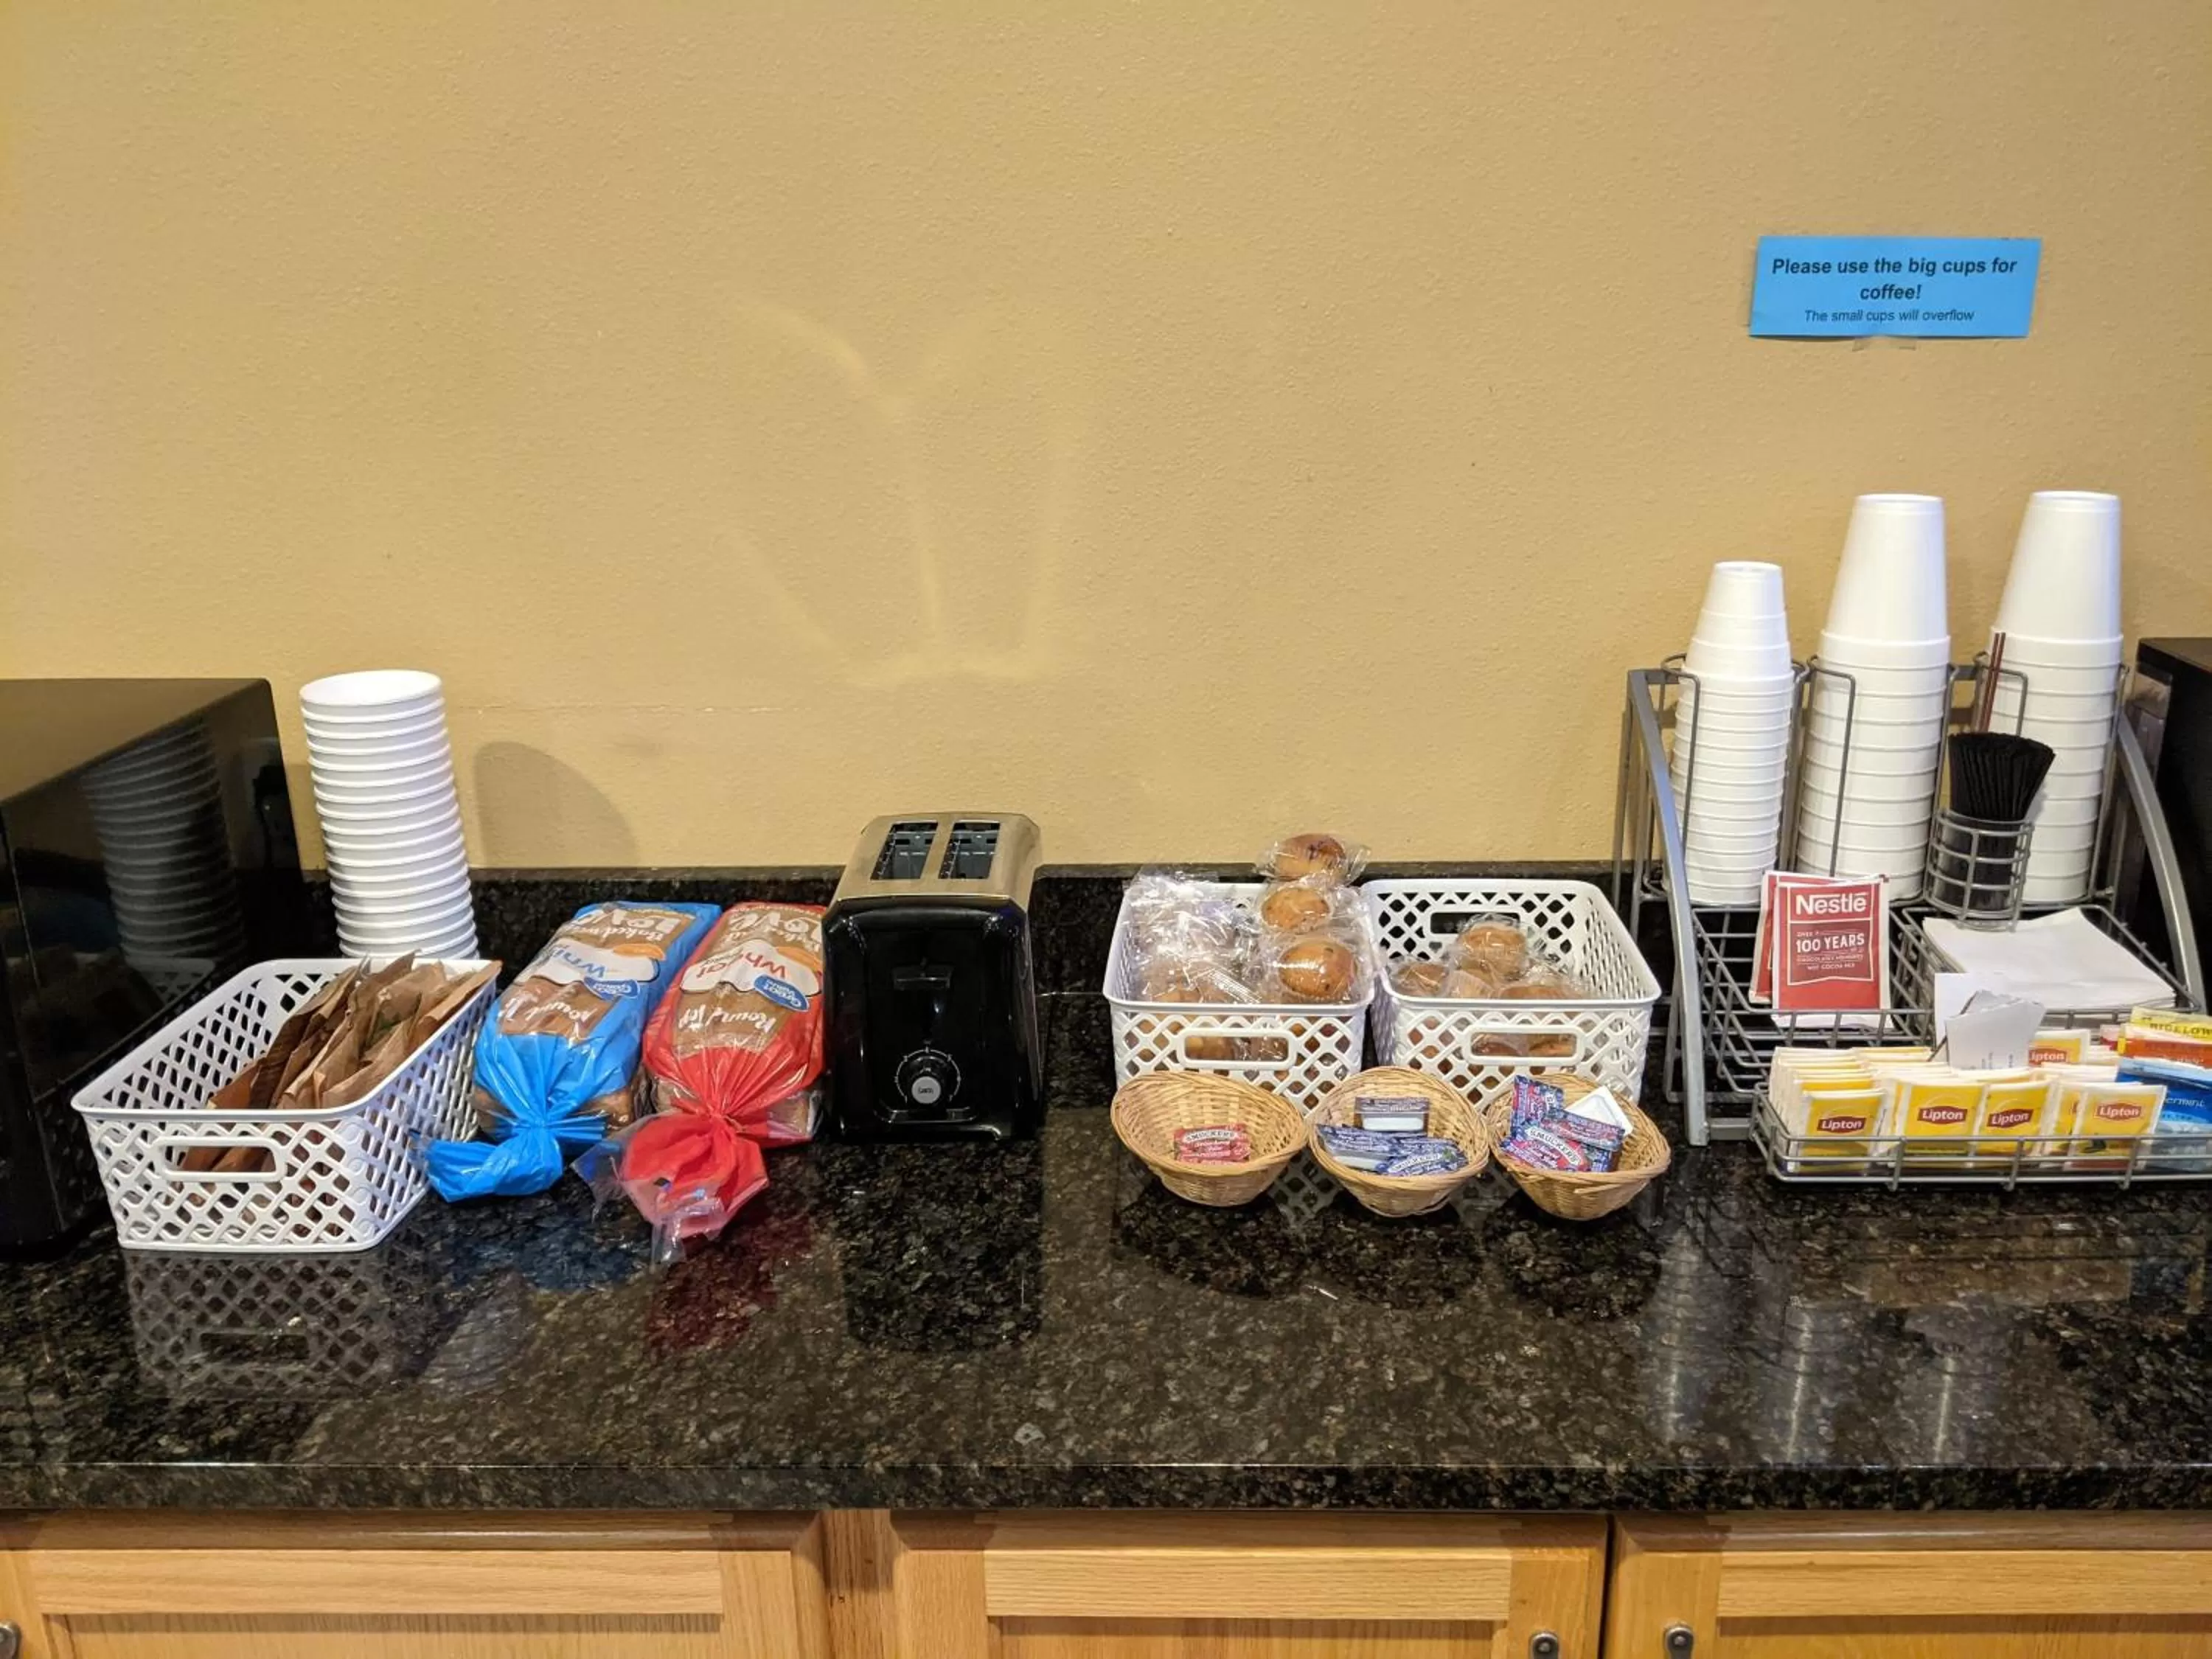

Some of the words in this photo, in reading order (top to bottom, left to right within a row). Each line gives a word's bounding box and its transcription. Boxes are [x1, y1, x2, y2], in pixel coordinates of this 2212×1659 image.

[1772, 258, 1832, 274] Please
[1837, 260, 1869, 274] use
[1874, 257, 1903, 274] the
[1907, 257, 1937, 276] big
[1942, 260, 1987, 276] cups
[1992, 257, 2018, 273] for
[1860, 283, 1922, 300] coffee!
[1804, 309, 1829, 321] The
[1831, 309, 1863, 321] small
[1865, 311, 1895, 324] cups
[1899, 309, 1919, 321] will
[1921, 309, 1975, 321] overflow
[1795, 939, 1821, 953] 100
[1824, 932, 1865, 950] YEARS
[2031, 1050, 2065, 1063] ipton
[1921, 1108, 1964, 1121] Lipton
[1991, 1111, 2030, 1126] Lipton
[2099, 1105, 2140, 1119] Lipton
[1821, 1119, 1863, 1131] Lipton
